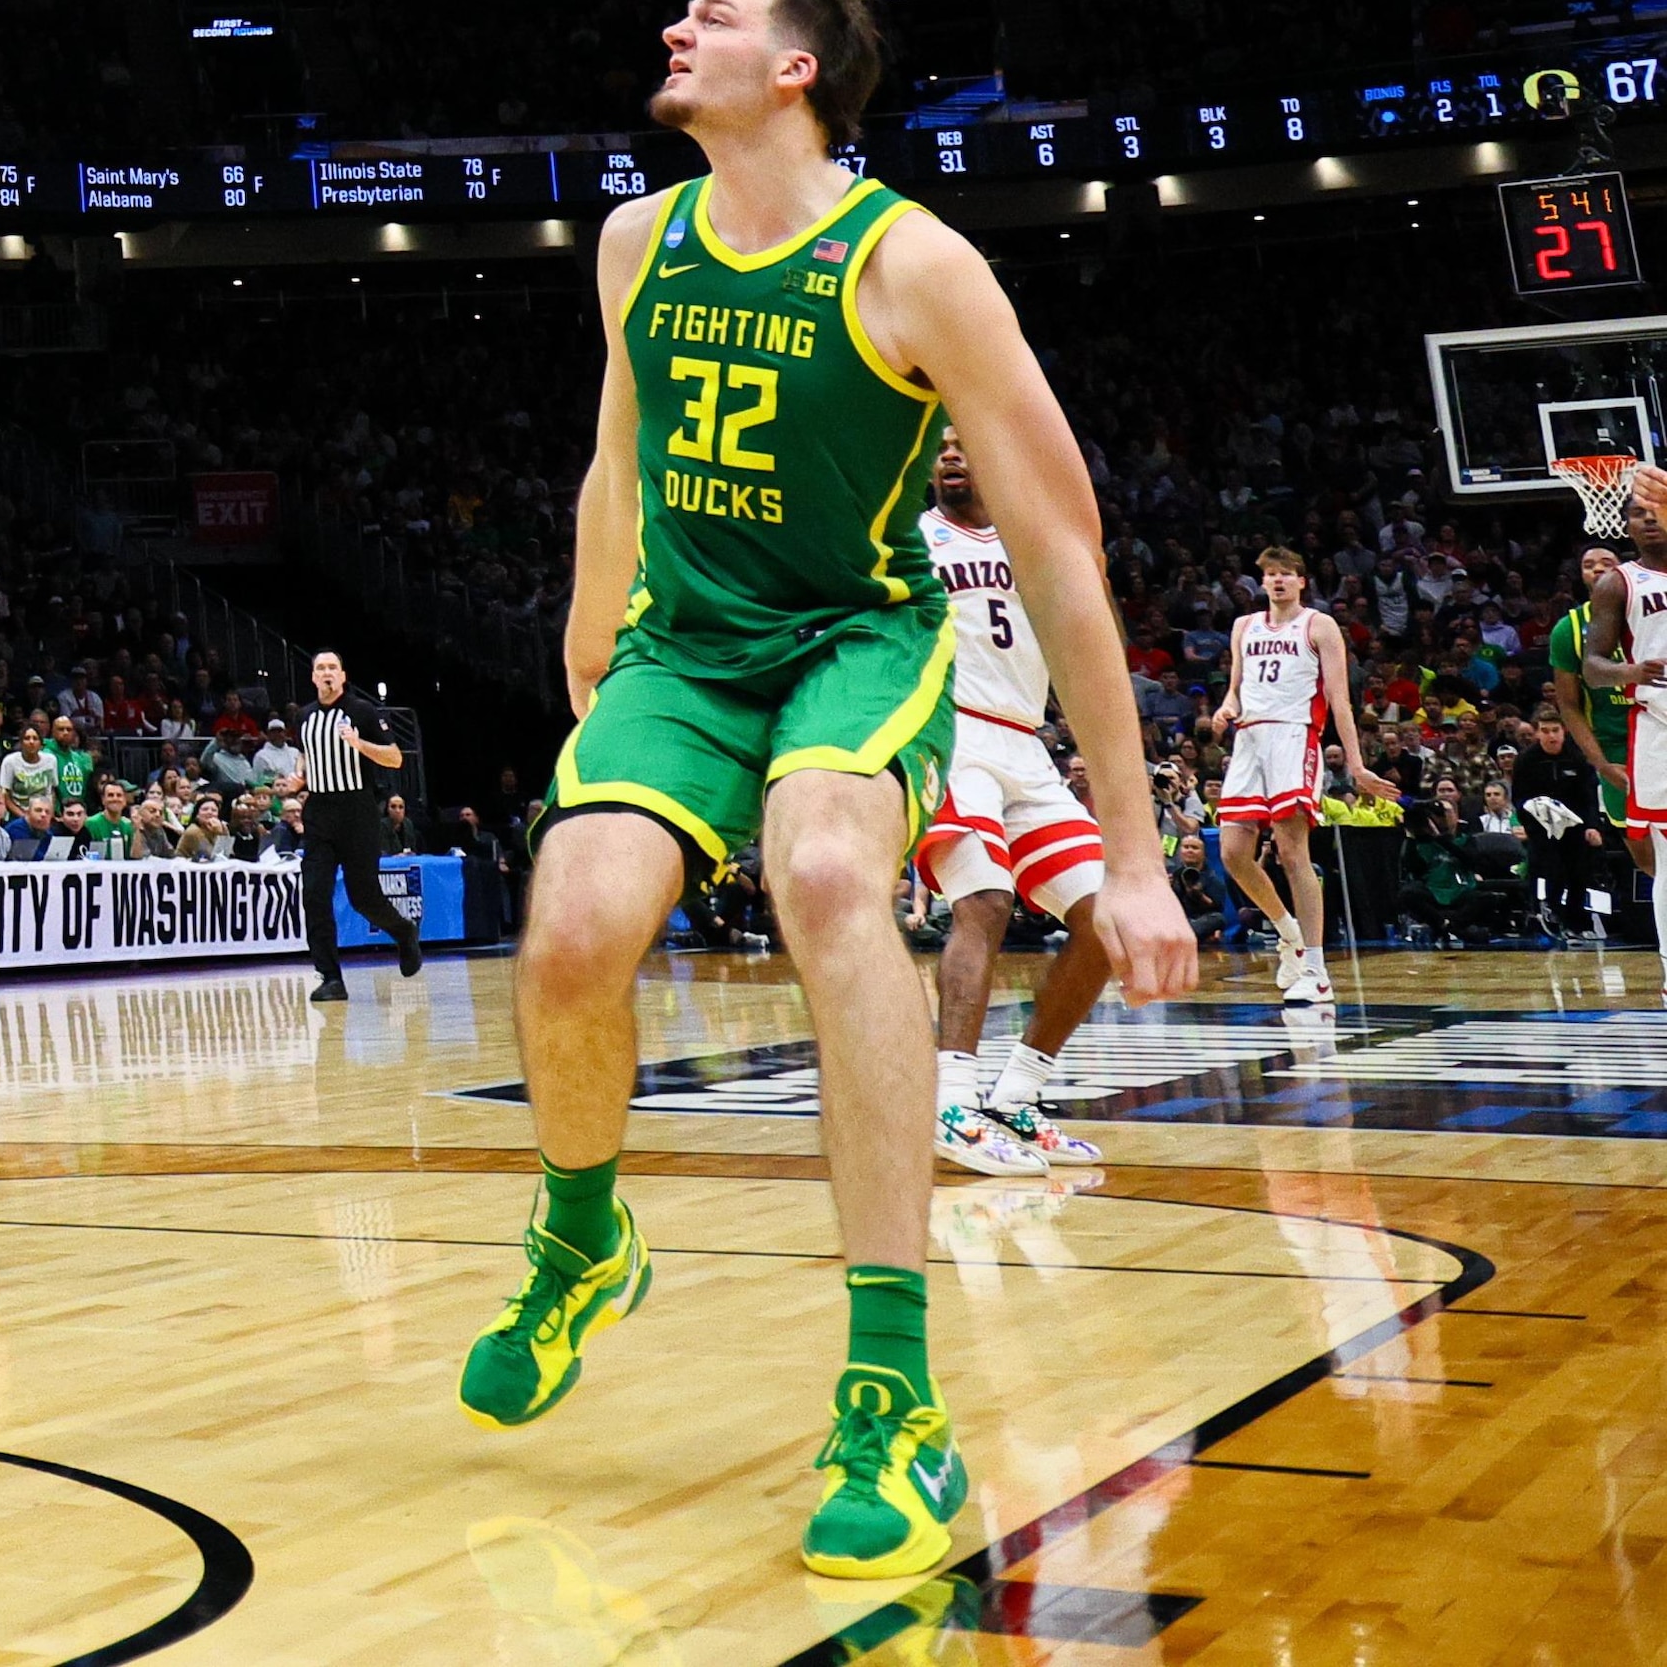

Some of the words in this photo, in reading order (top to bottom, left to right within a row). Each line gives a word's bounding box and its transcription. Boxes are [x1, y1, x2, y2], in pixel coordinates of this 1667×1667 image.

[193, 28, 232, 37] SECOND
[233, 27, 273, 36] ROUNDS
[213, 19, 243, 28] FIRST
[1430, 80, 1452, 94] FLS
[1478, 74, 1500, 89] TOL
[1606, 58, 1657, 104] 67
[1364, 85, 1405, 101] BONUS
[1199, 106, 1227, 123] BLK
[1280, 98, 1301, 113] TO
[1436, 99, 1454, 122] 2
[1486, 93, 1502, 117] 1
[1030, 125, 1055, 140] AST
[1115, 116, 1140, 132] STL
[1287, 117, 1304, 141] 8
[937, 131, 963, 146] REB
[1123, 136, 1140, 159] 3
[1208, 126, 1225, 149] 3
[608, 155, 634, 169] FG%
[939, 150, 966, 173] 31
[1038, 144, 1055, 166] 6
[0, 166, 17, 183] 75
[87, 167, 126, 184] Saint
[129, 168, 179, 188] Mary's
[223, 166, 244, 183] 66
[320, 162, 375, 180] Illinois
[379, 161, 422, 178] State
[463, 159, 483, 176] 78
[493, 169, 501, 185] F
[27, 176, 35, 193] F
[254, 176, 263, 193] F
[322, 184, 423, 206] Presbyterian
[466, 182, 485, 199] 70
[601, 172, 645, 195] 45.8
[0, 189, 19, 206] 84
[88, 190, 152, 208] Alabama
[224, 189, 246, 206] 80
[1534, 221, 1616, 280] 27
[649, 303, 817, 358] FIGHTING
[667, 356, 779, 472] 32
[665, 469, 783, 525] DUCKS
[198, 501, 268, 525] EXIT
[987, 599, 1014, 650] 5
[1245, 640, 1300, 657] ARIZONA
[1258, 659, 1281, 684] 13
[62, 872, 103, 950] OF
[113, 869, 303, 947] WASHINGTON
